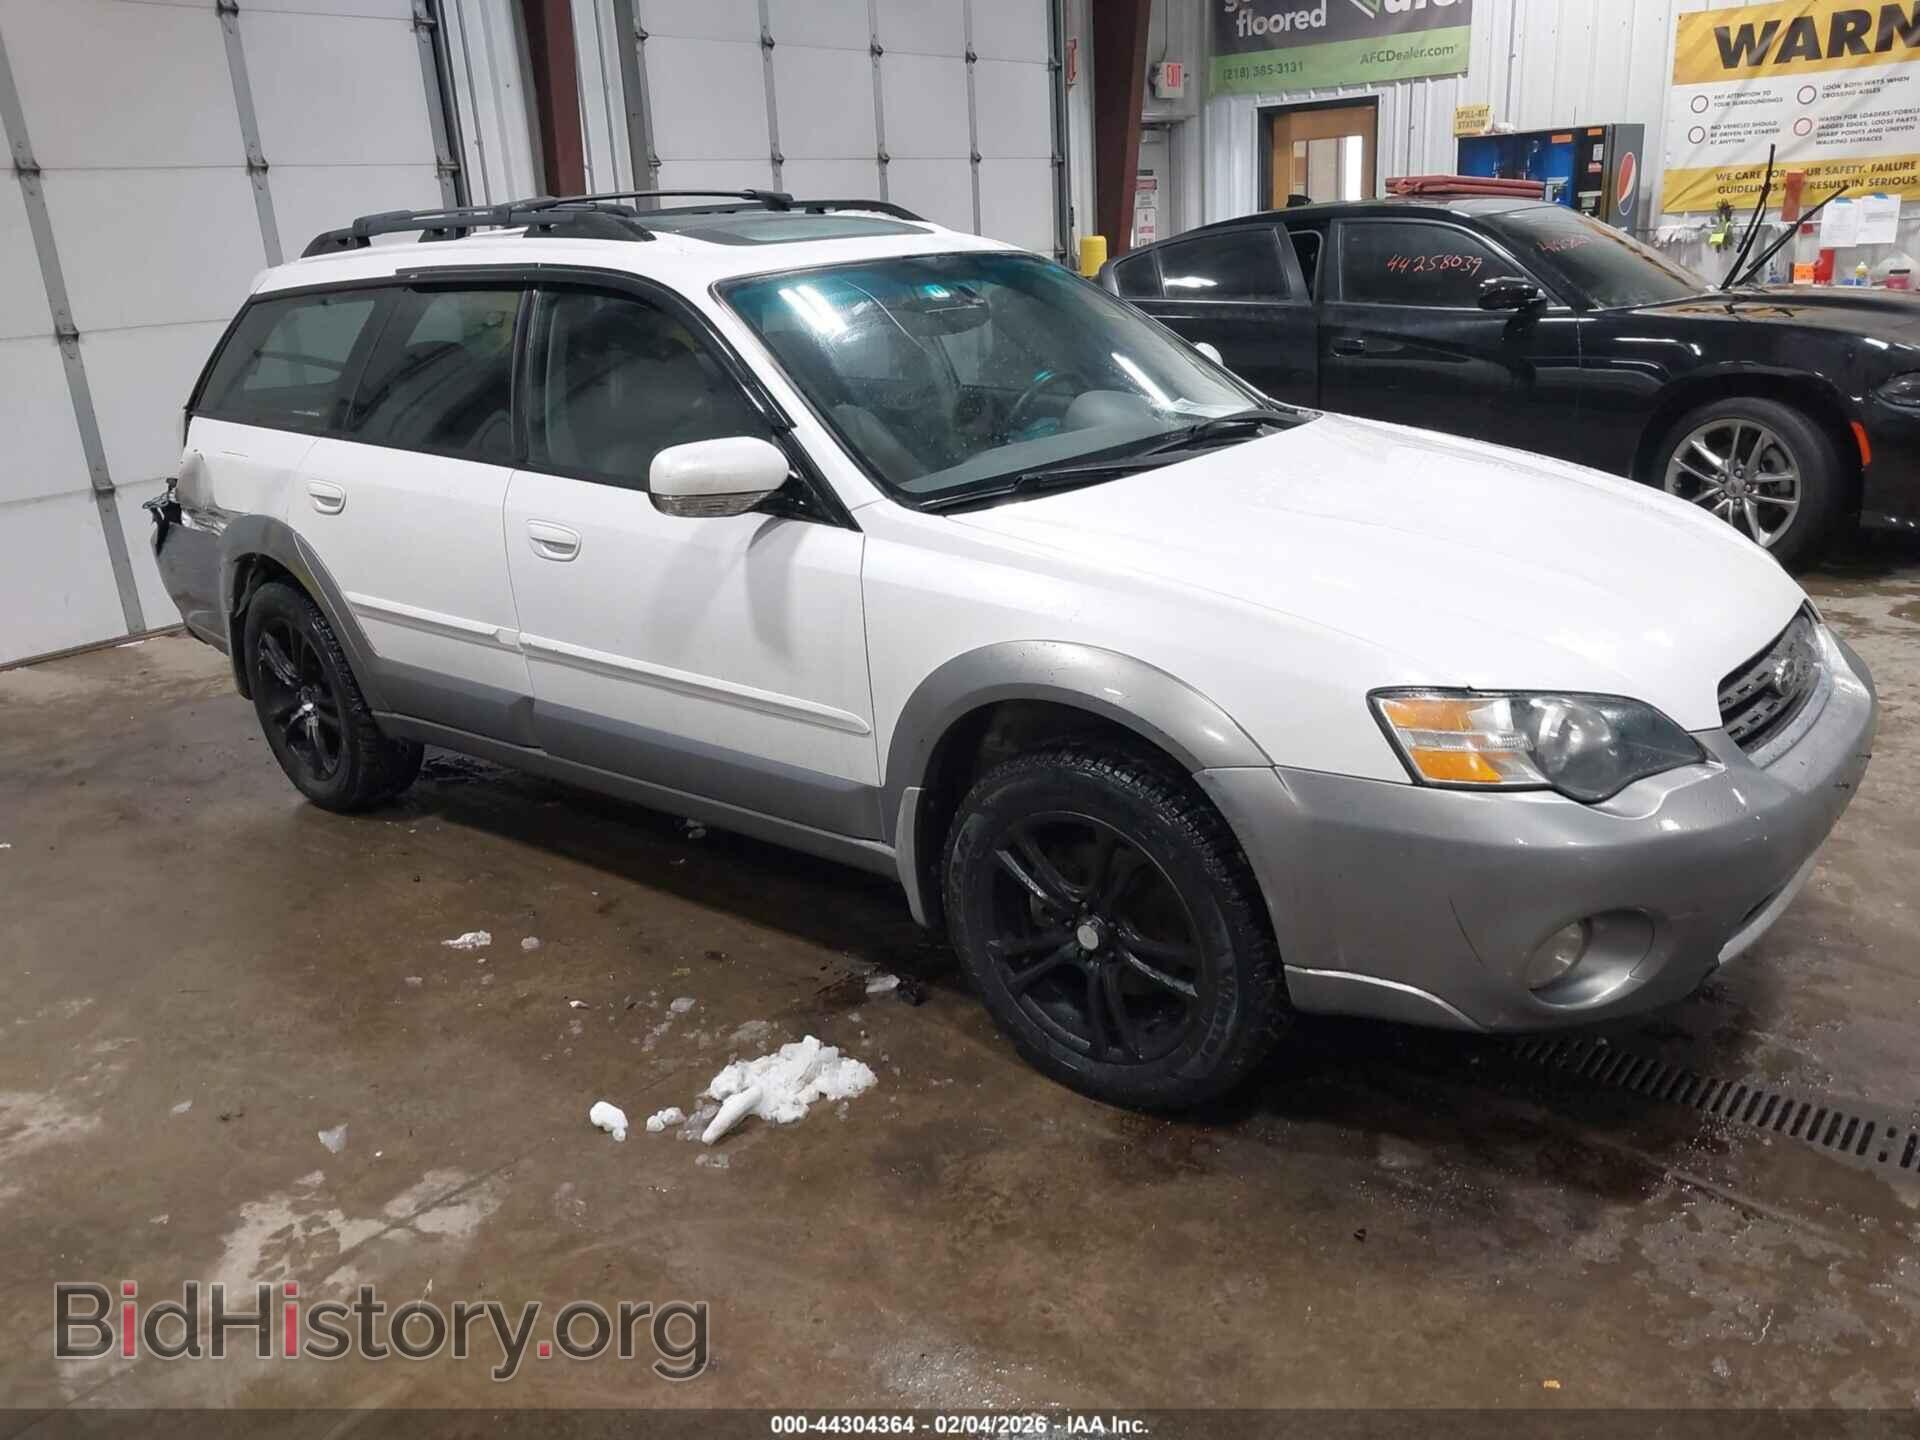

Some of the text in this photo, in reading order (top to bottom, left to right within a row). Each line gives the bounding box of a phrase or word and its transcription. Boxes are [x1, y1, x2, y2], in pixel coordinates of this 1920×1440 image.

[1236, 0, 1327, 37] floored
[1714, 1, 1920, 69] WARN
[1716, 172, 1733, 181] WE
[1735, 170, 1762, 181] CARE
[1871, 160, 1917, 173] FAILURE
[1849, 178, 1865, 188] IN
[1868, 175, 1918, 187] SERIOUS
[1387, 254, 1482, 277] 44258039
